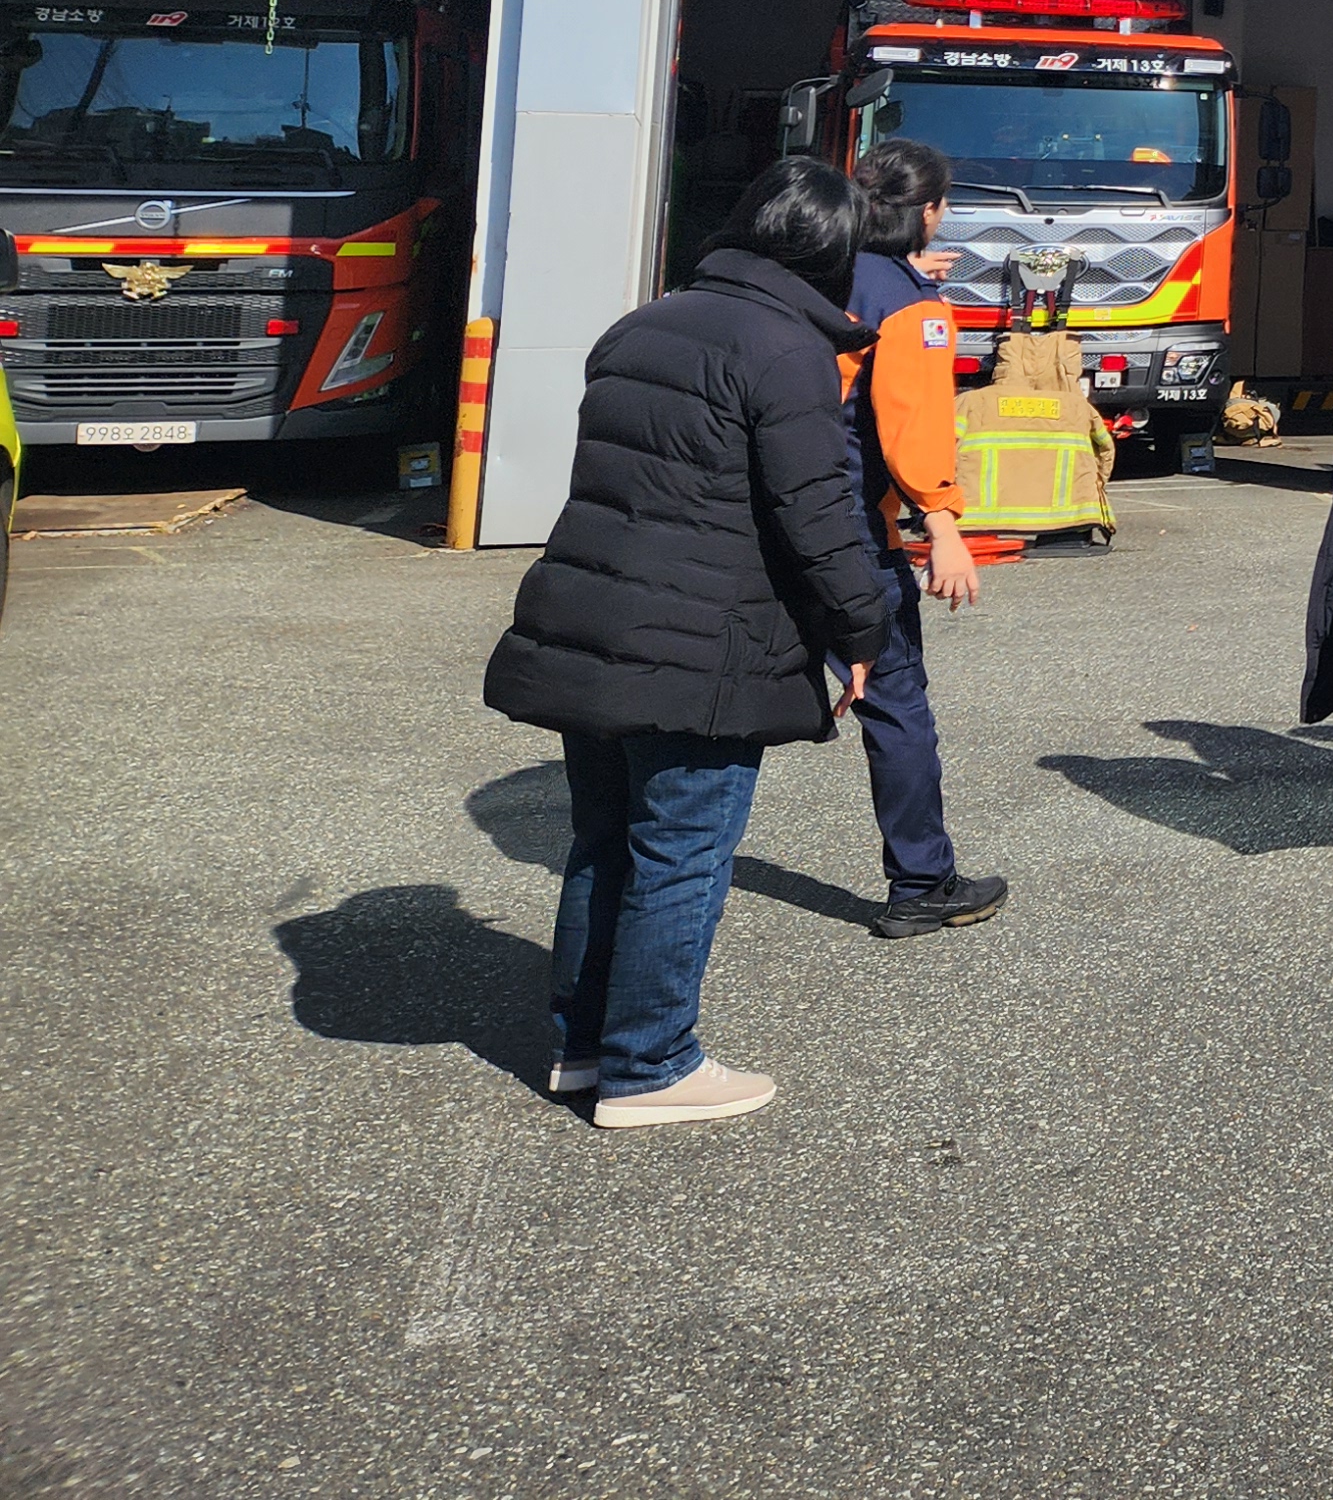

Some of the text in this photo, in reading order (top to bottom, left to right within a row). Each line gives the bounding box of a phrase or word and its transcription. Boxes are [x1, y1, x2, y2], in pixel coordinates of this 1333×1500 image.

[34, 6, 104, 24] 경남소방
[943, 51, 1011, 68] 경남소방
[1096, 57, 1166, 73] 거제 13호
[1157, 388, 1208, 401] 거제 13호
[85, 425, 188, 441] 998오 2848
